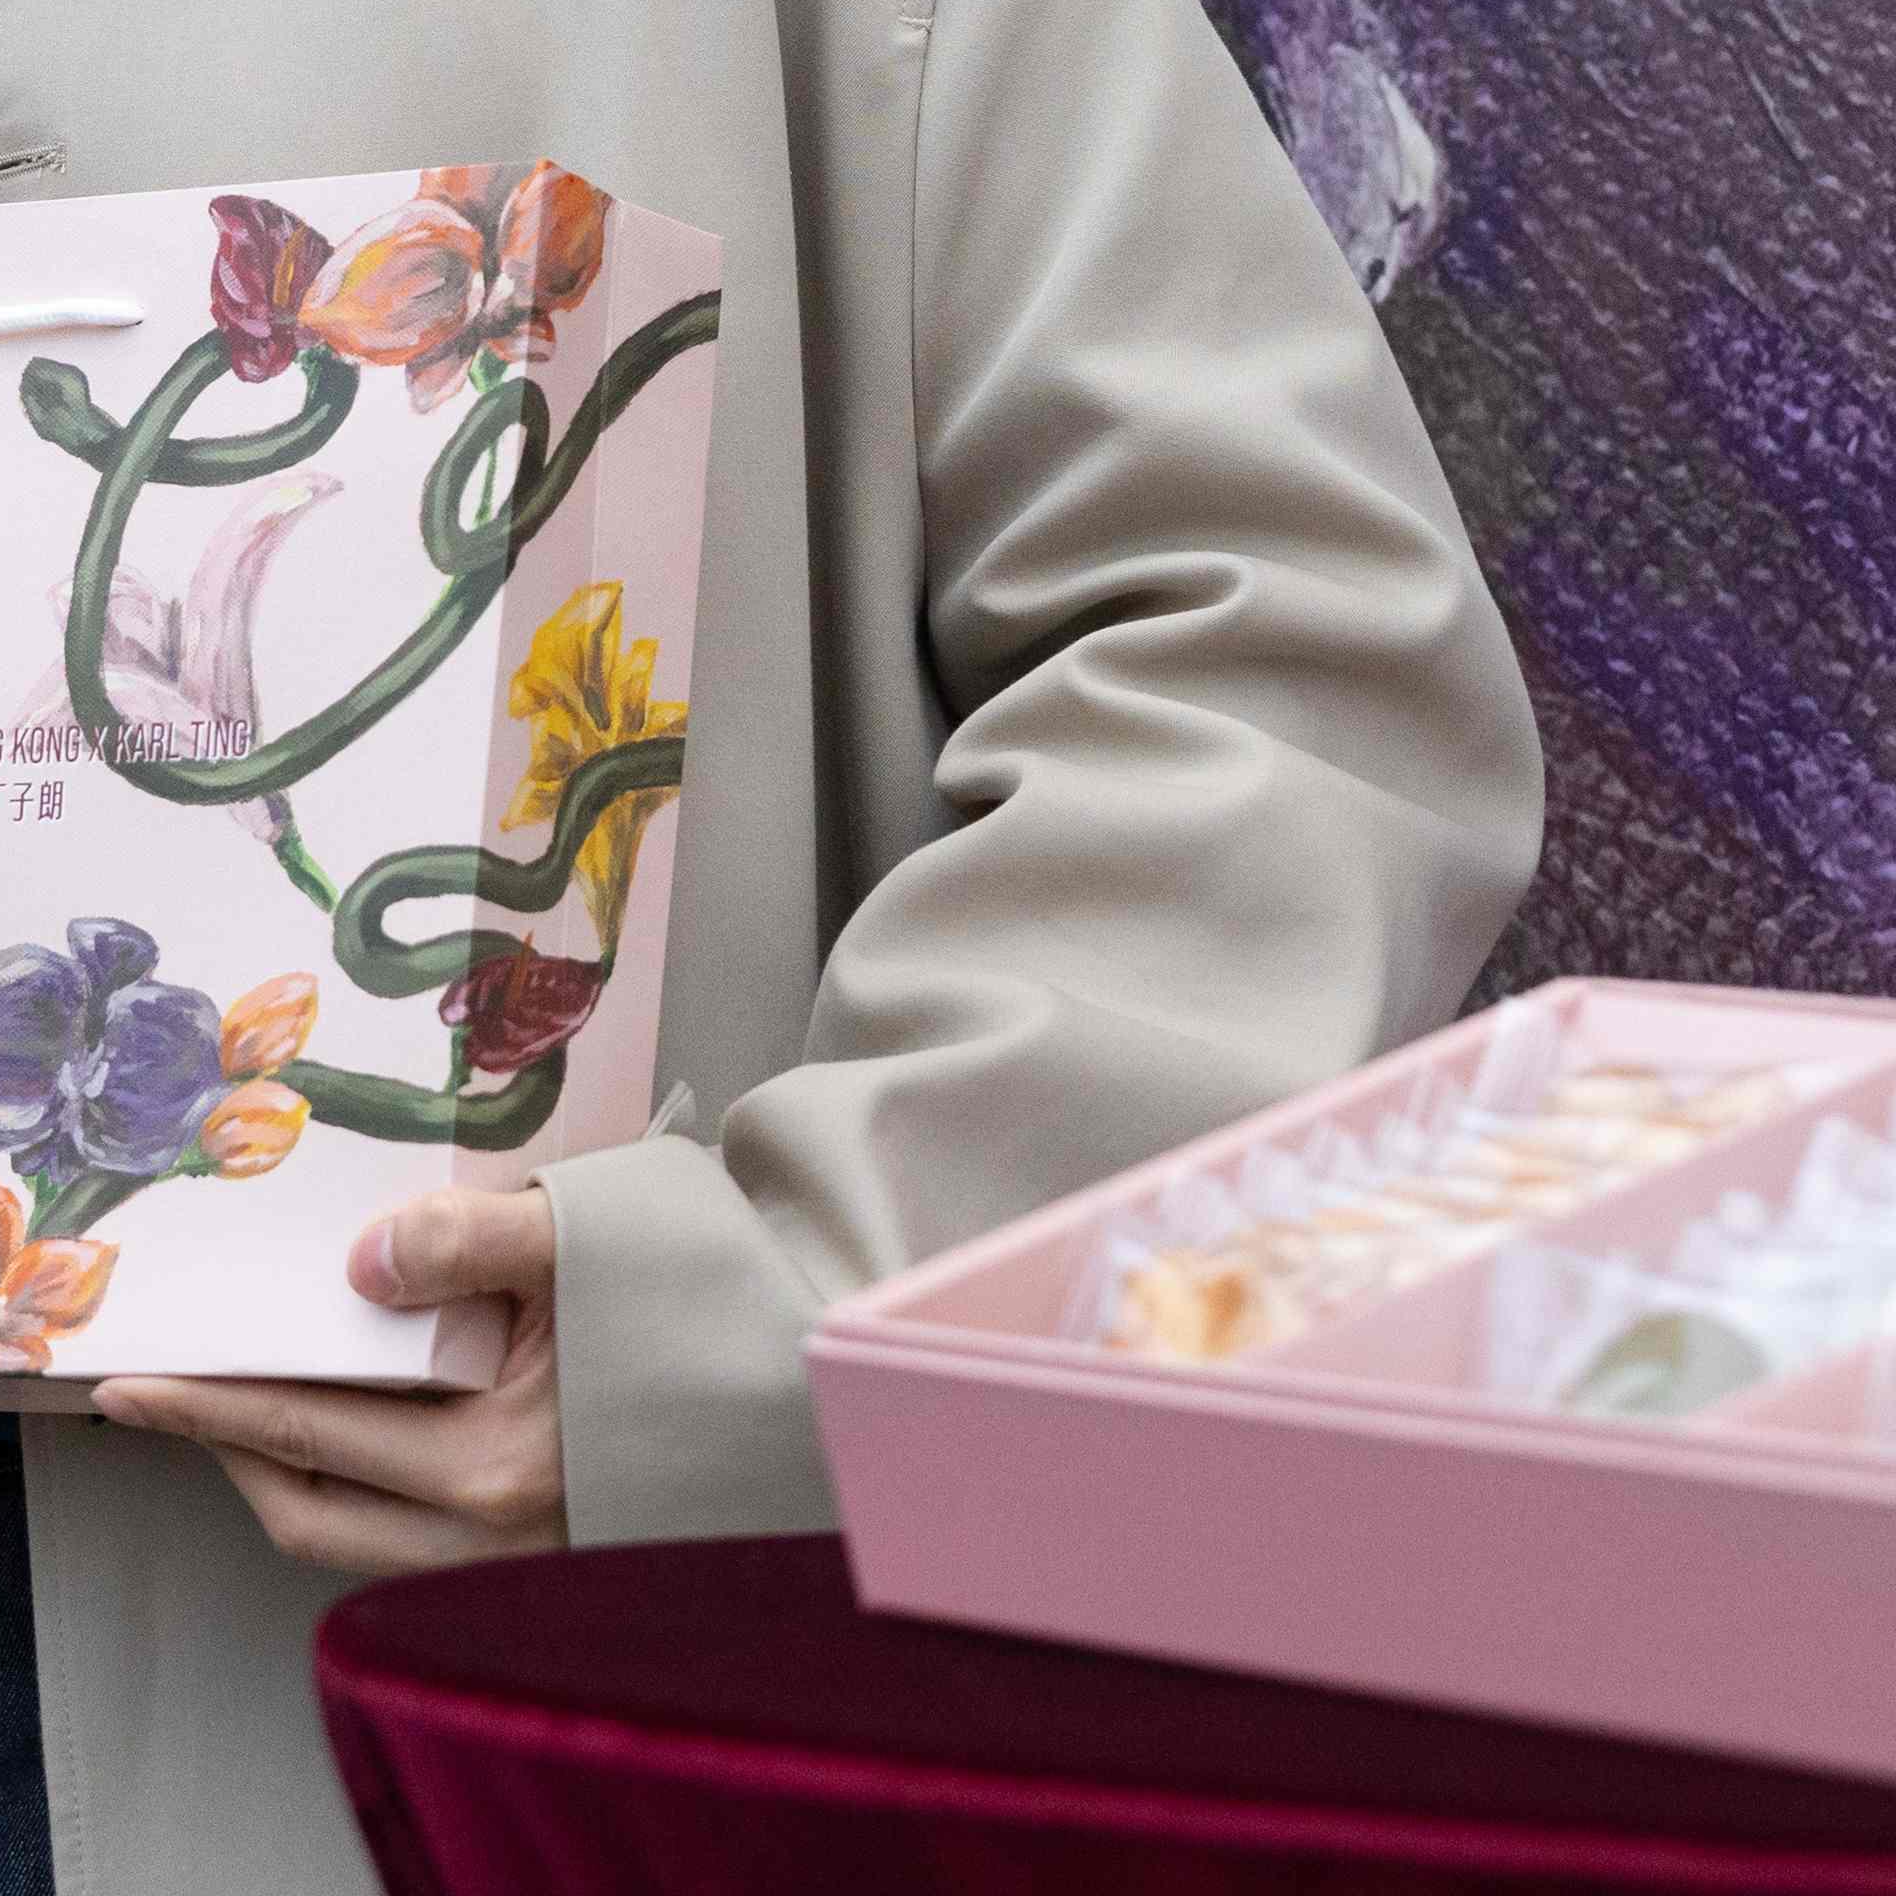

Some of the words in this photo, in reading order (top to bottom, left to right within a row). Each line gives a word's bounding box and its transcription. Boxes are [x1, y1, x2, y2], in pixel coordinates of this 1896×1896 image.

[12, 726, 80, 764] KONG
[87, 725, 108, 762] X
[115, 722, 181, 763] KARL
[191, 718, 250, 761] TING
